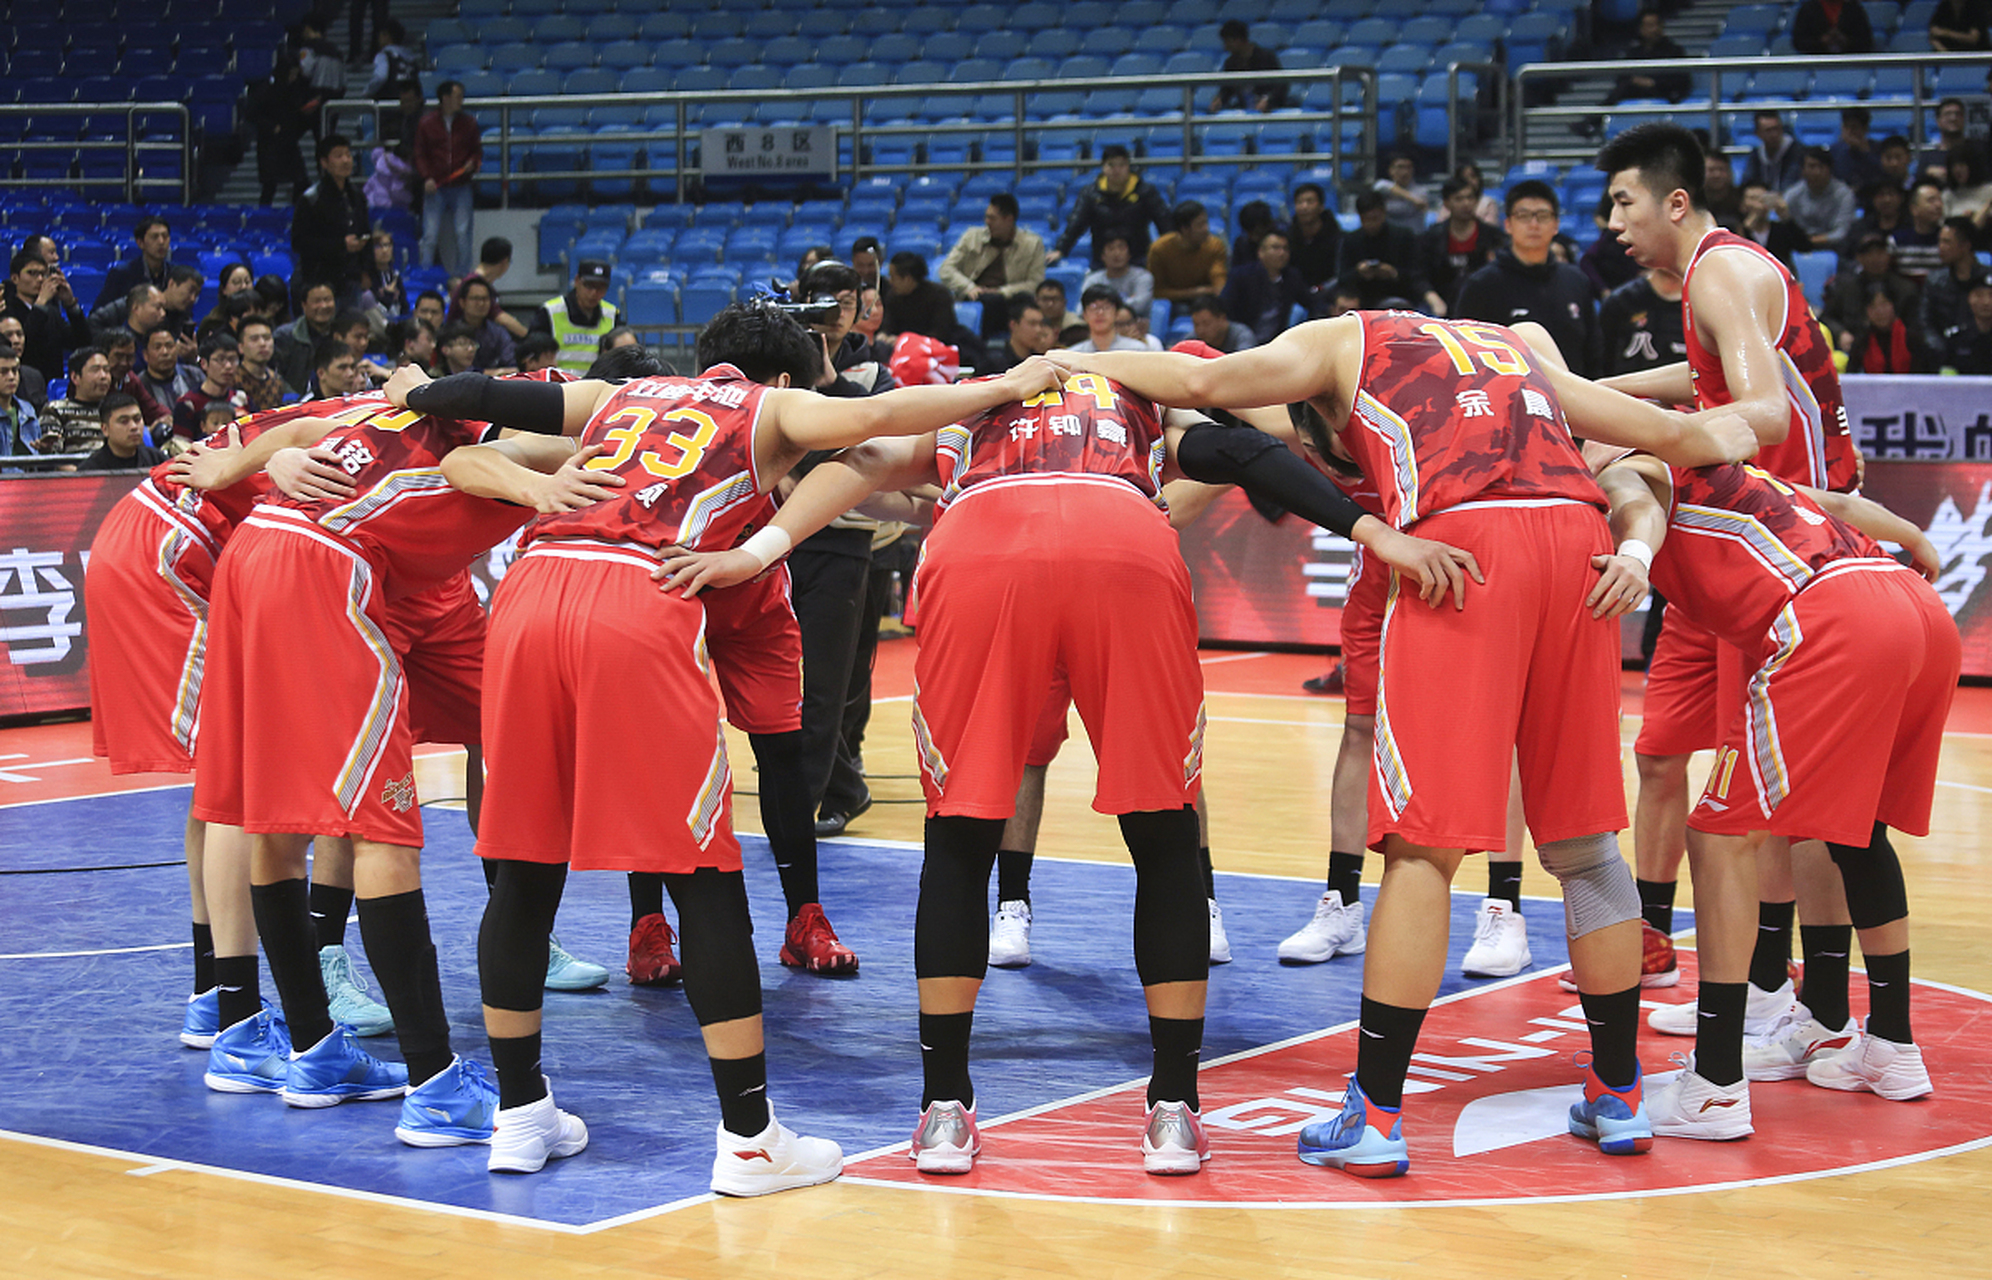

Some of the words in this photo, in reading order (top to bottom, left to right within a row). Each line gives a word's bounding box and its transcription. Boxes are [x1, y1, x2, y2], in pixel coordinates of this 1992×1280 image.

[727, 156, 755, 168] West
[1419, 323, 1531, 376] 15
[582, 406, 720, 480] 33
